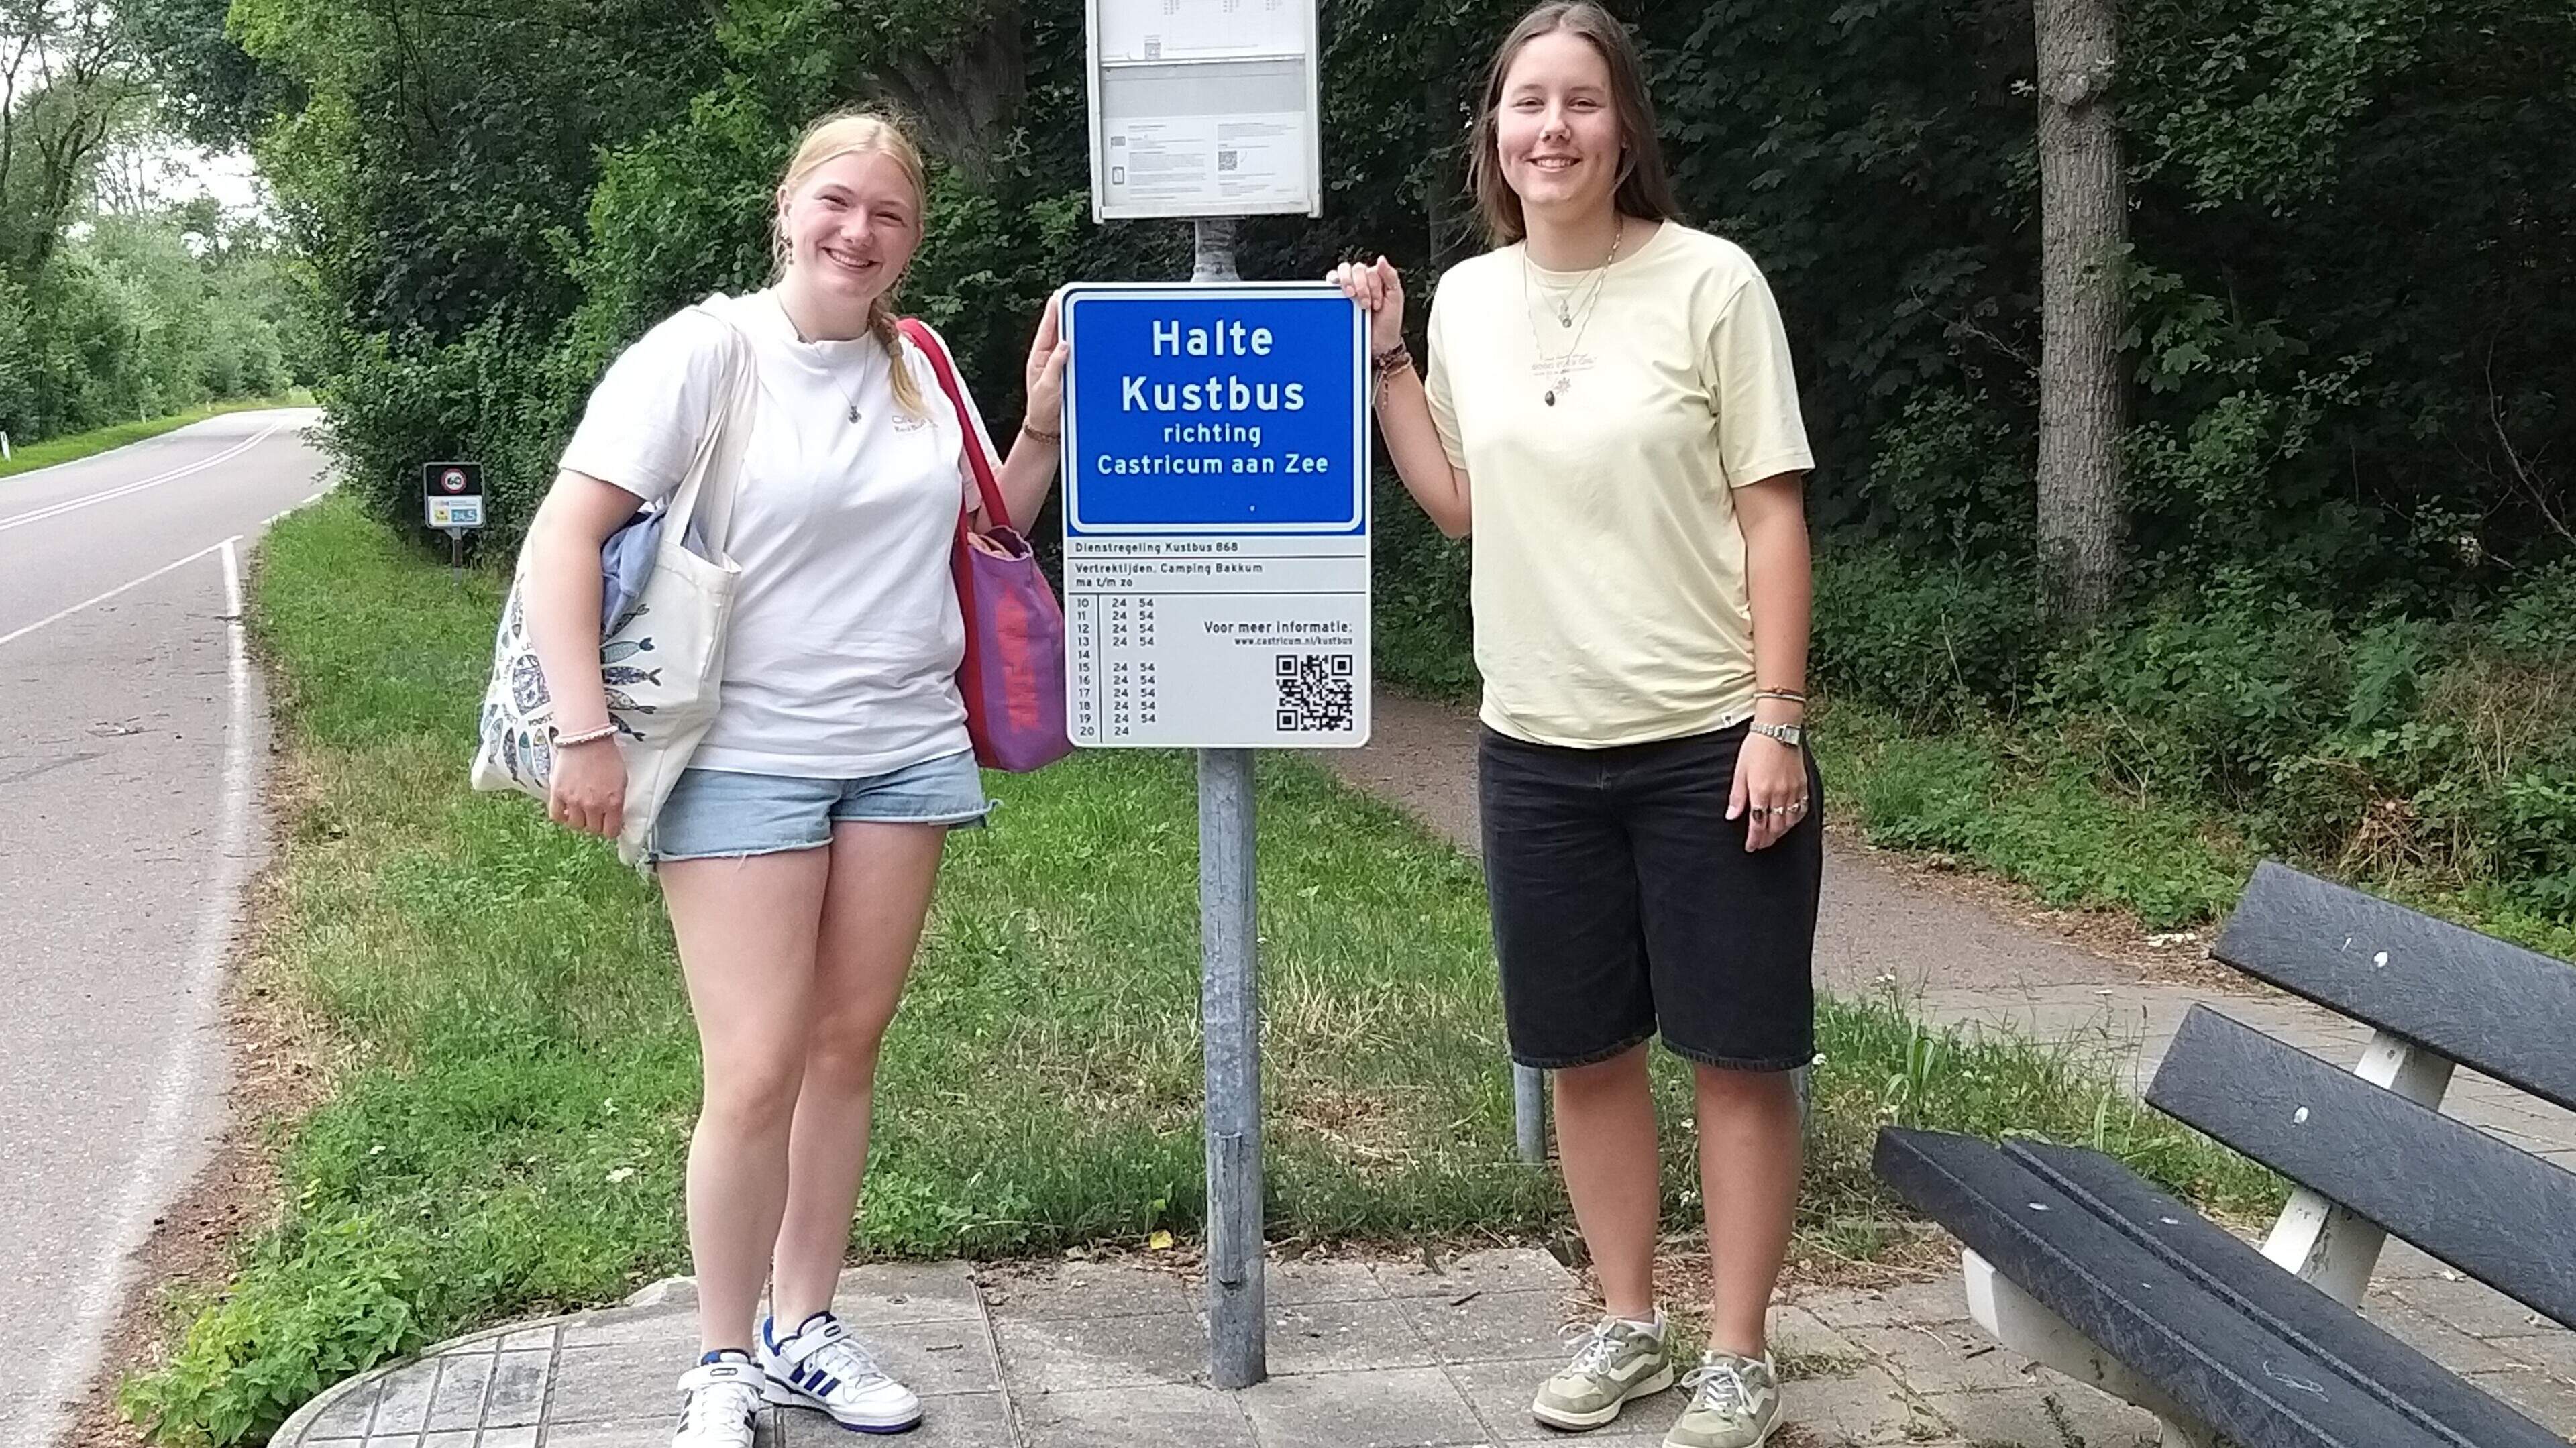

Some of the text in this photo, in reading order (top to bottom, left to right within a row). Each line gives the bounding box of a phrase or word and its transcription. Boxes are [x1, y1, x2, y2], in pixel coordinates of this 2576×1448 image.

[1152, 319, 1273, 356] Halte
[1122, 375, 1304, 411] Kustbus
[1164, 423, 1260, 448] richting
[1097, 453, 1328, 474] Castricum aan Zee
[447, 476, 462, 485] 60
[1075, 542, 1238, 555] Dienstregeling Kustbus 868
[1161, 563, 1211, 575] Camping
[1216, 563, 1263, 573] Bakkum
[1076, 577, 1133, 588] ma t/m zo
[1077, 598, 1154, 608] 10 24 54
[1077, 610, 1154, 621] 11 24 54
[1077, 623, 1154, 634] 12 24 54
[1204, 620, 1352, 634] Voor meer informatie:
[1078, 636, 1154, 647] 13 24 54
[1234, 636, 1353, 645] www.castricum.nl/kustbus
[1078, 650, 1090, 659] 14
[1079, 662, 1155, 673] 15 24 54
[1079, 675, 1155, 685] 16 24 54
[1079, 688, 1155, 698] 17 24 54
[1079, 701, 1155, 711] 18 24 54
[1079, 713, 1156, 724] 19 24 54
[1080, 726, 1129, 736] 20 24
